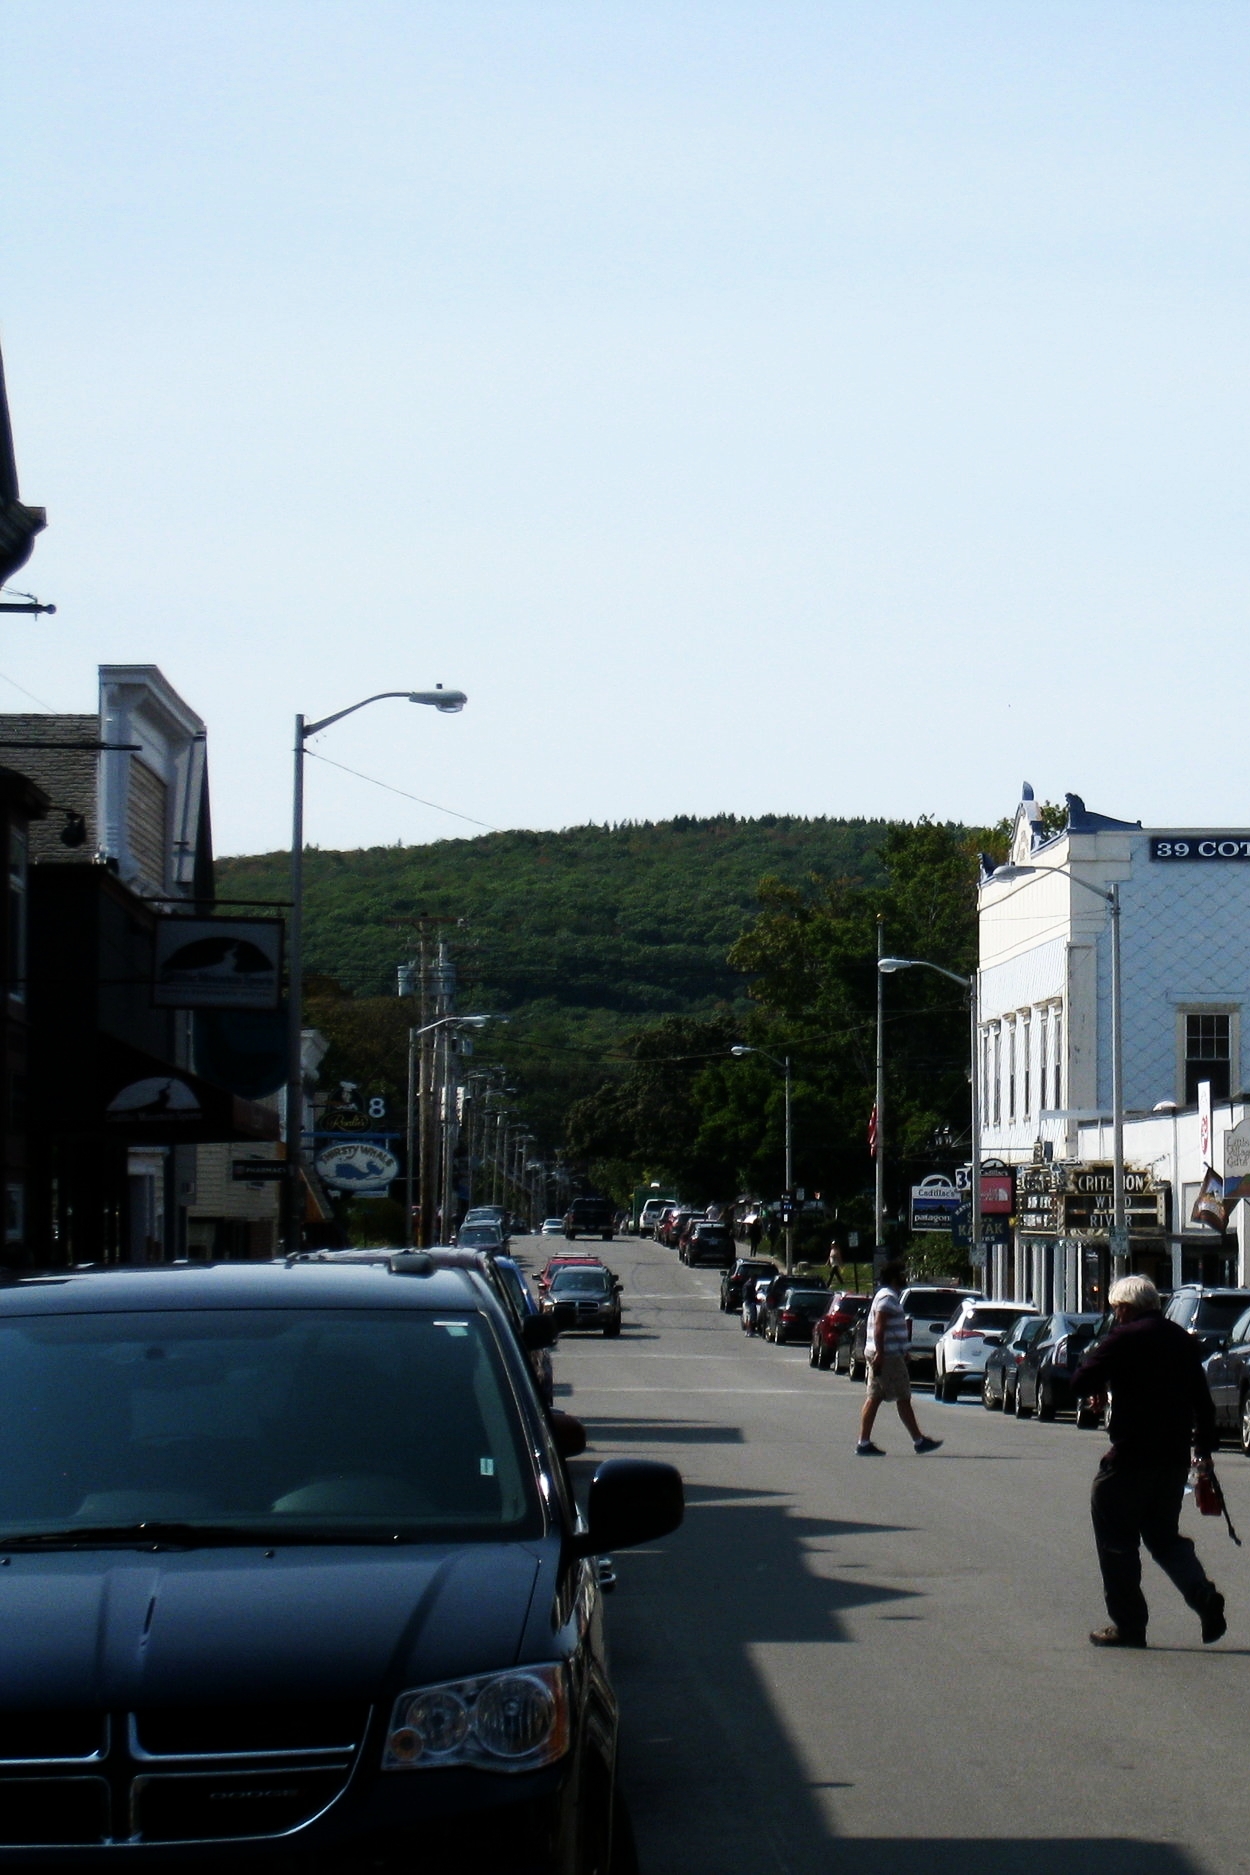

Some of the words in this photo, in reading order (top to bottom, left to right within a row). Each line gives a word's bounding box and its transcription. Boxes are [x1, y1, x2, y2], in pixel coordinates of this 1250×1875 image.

[1157, 841, 1190, 857] 39
[368, 1097, 386, 1118] 8
[1078, 1174, 1145, 1192] CRITEION
[1095, 1196, 1132, 1209] WID
[1090, 1214, 1133, 1227] RIVR
